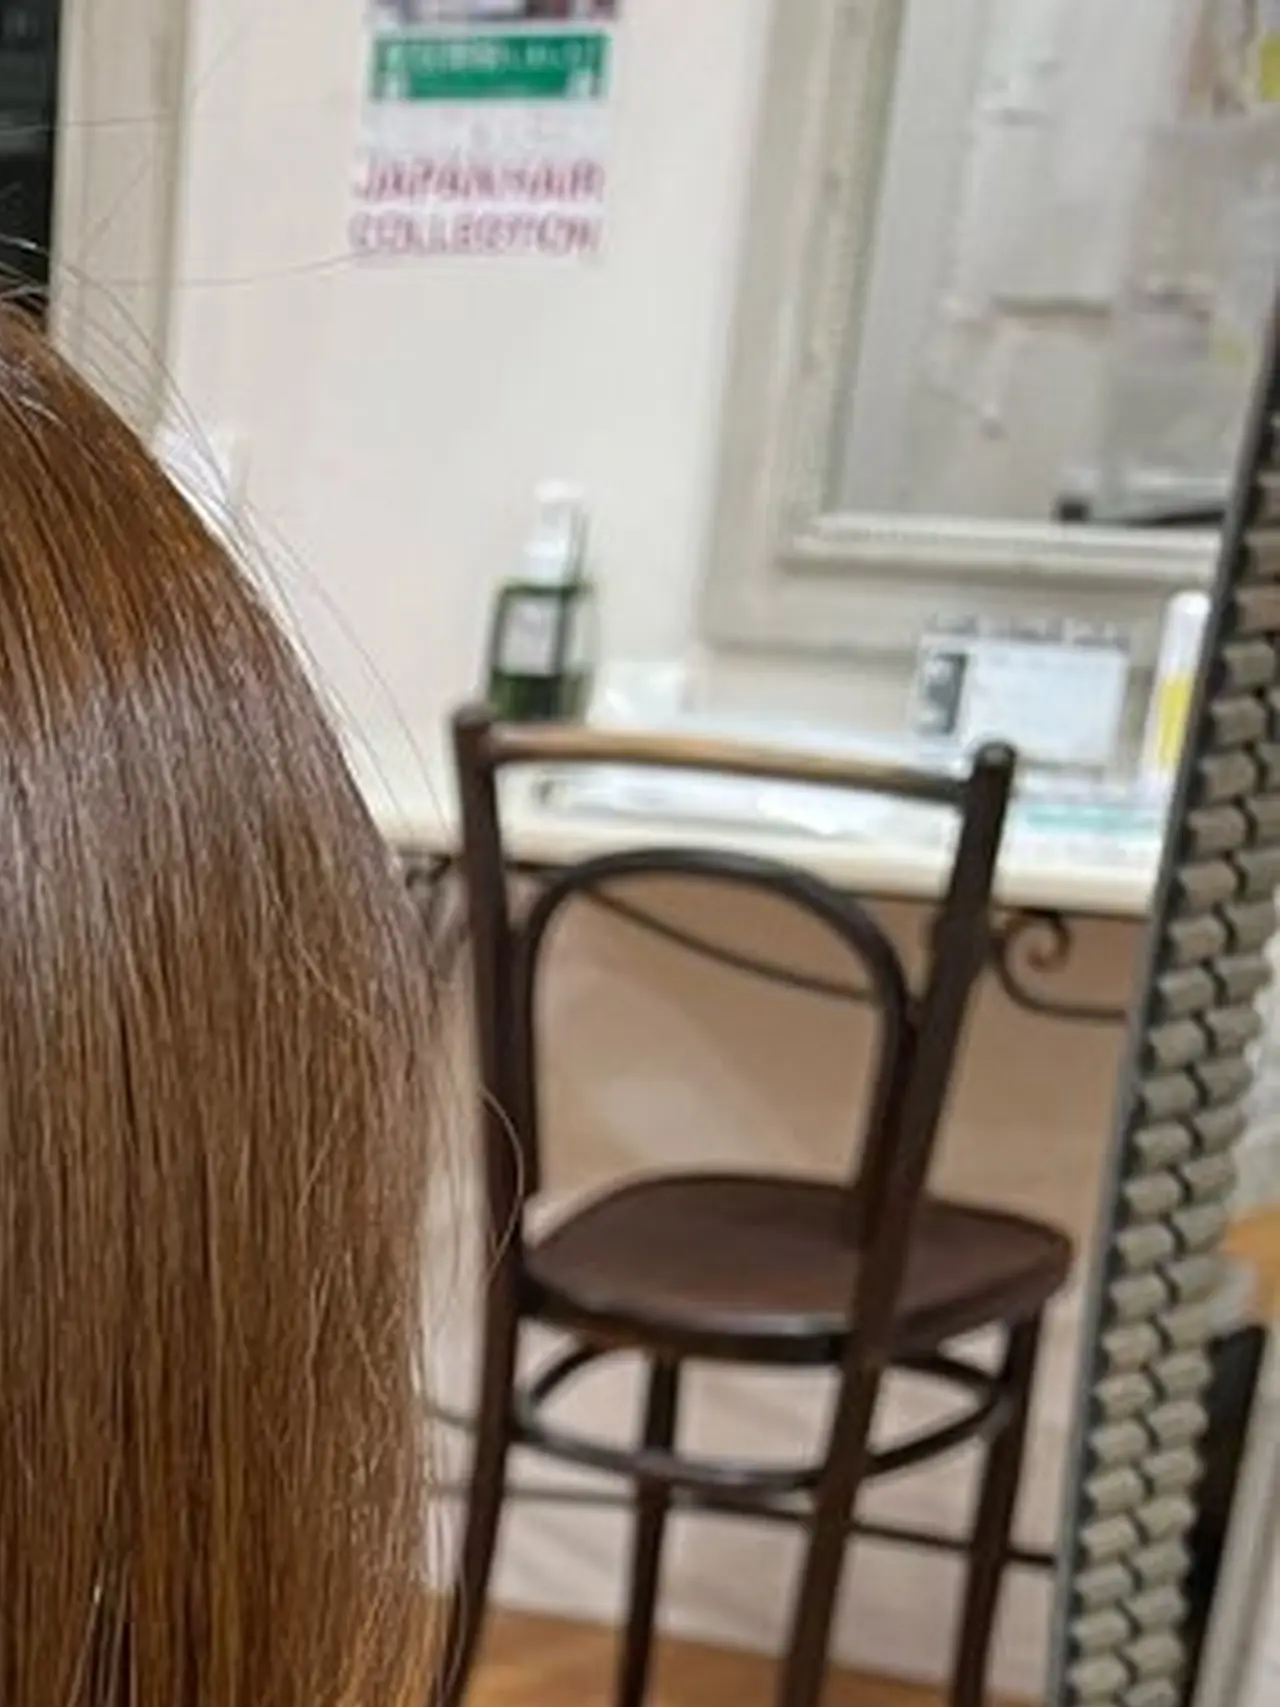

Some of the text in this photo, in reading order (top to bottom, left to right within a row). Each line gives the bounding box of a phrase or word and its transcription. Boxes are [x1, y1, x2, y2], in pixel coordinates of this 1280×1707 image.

[351, 156, 605, 202] JAPAN HAIR
[346, 208, 603, 255] COLLECTION
